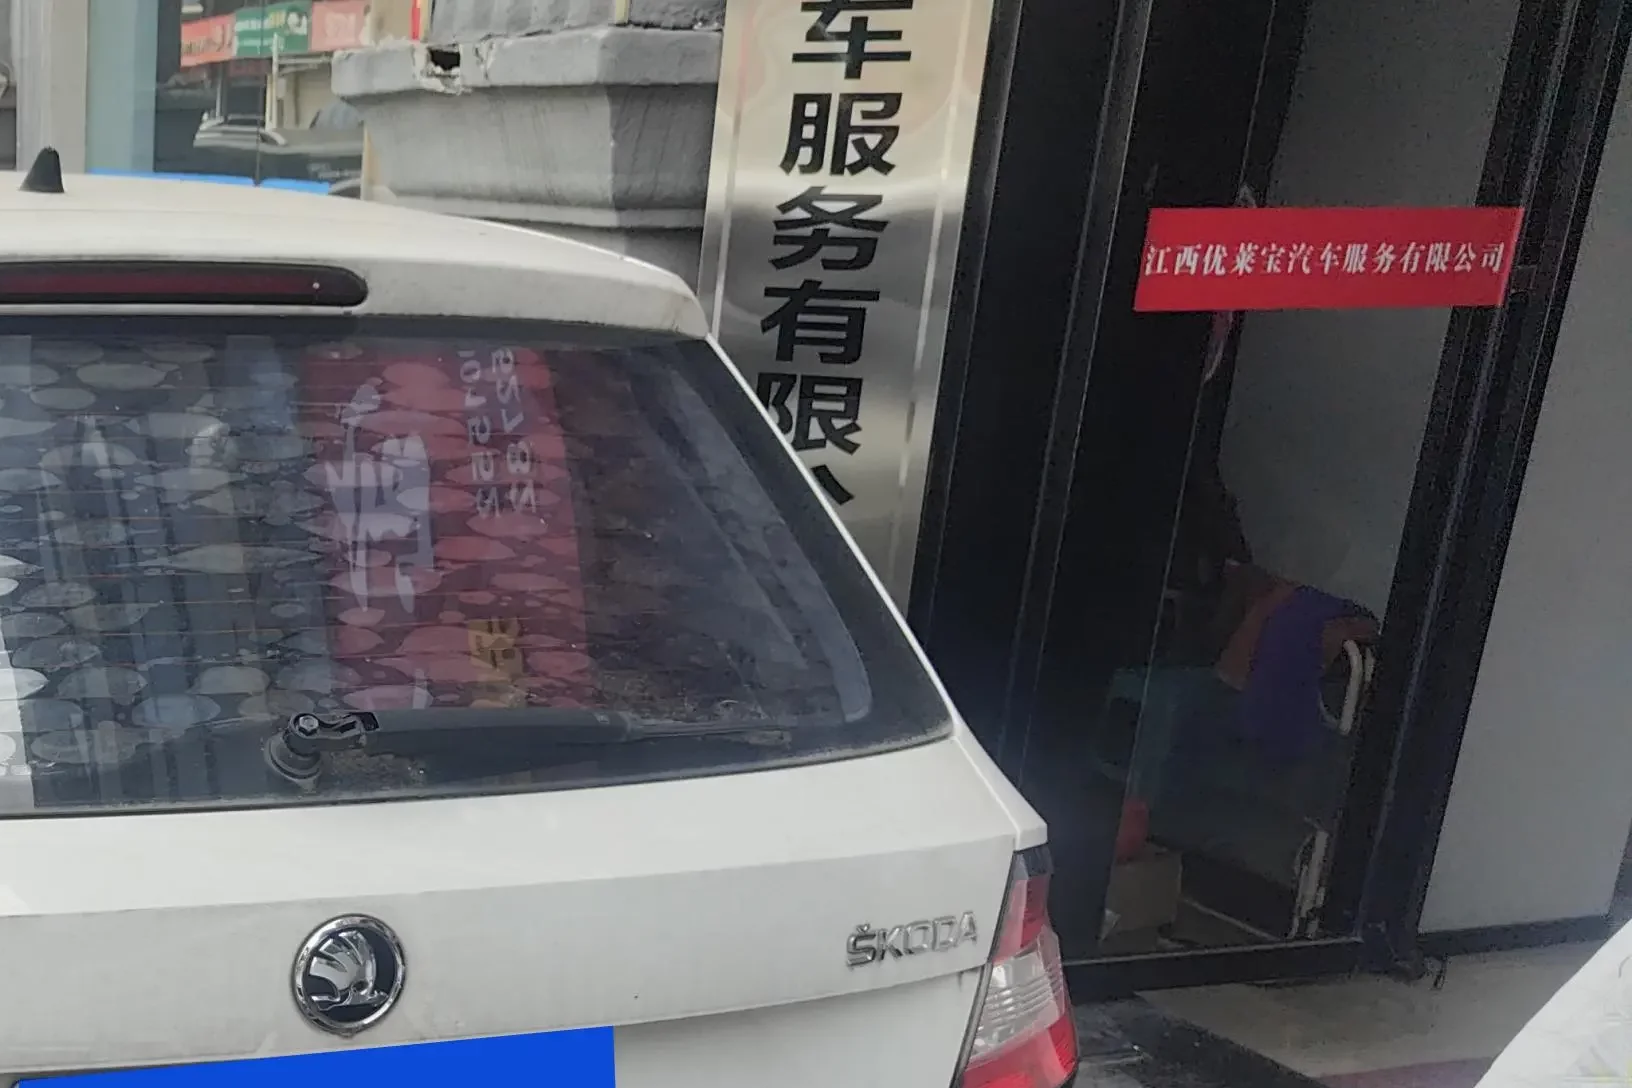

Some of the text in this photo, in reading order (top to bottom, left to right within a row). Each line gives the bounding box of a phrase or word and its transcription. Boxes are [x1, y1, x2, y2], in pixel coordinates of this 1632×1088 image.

[756, 0, 914, 506] 车服务有限
[1144, 241, 1506, 275] 江西优莱宝汽车服务有限公司
